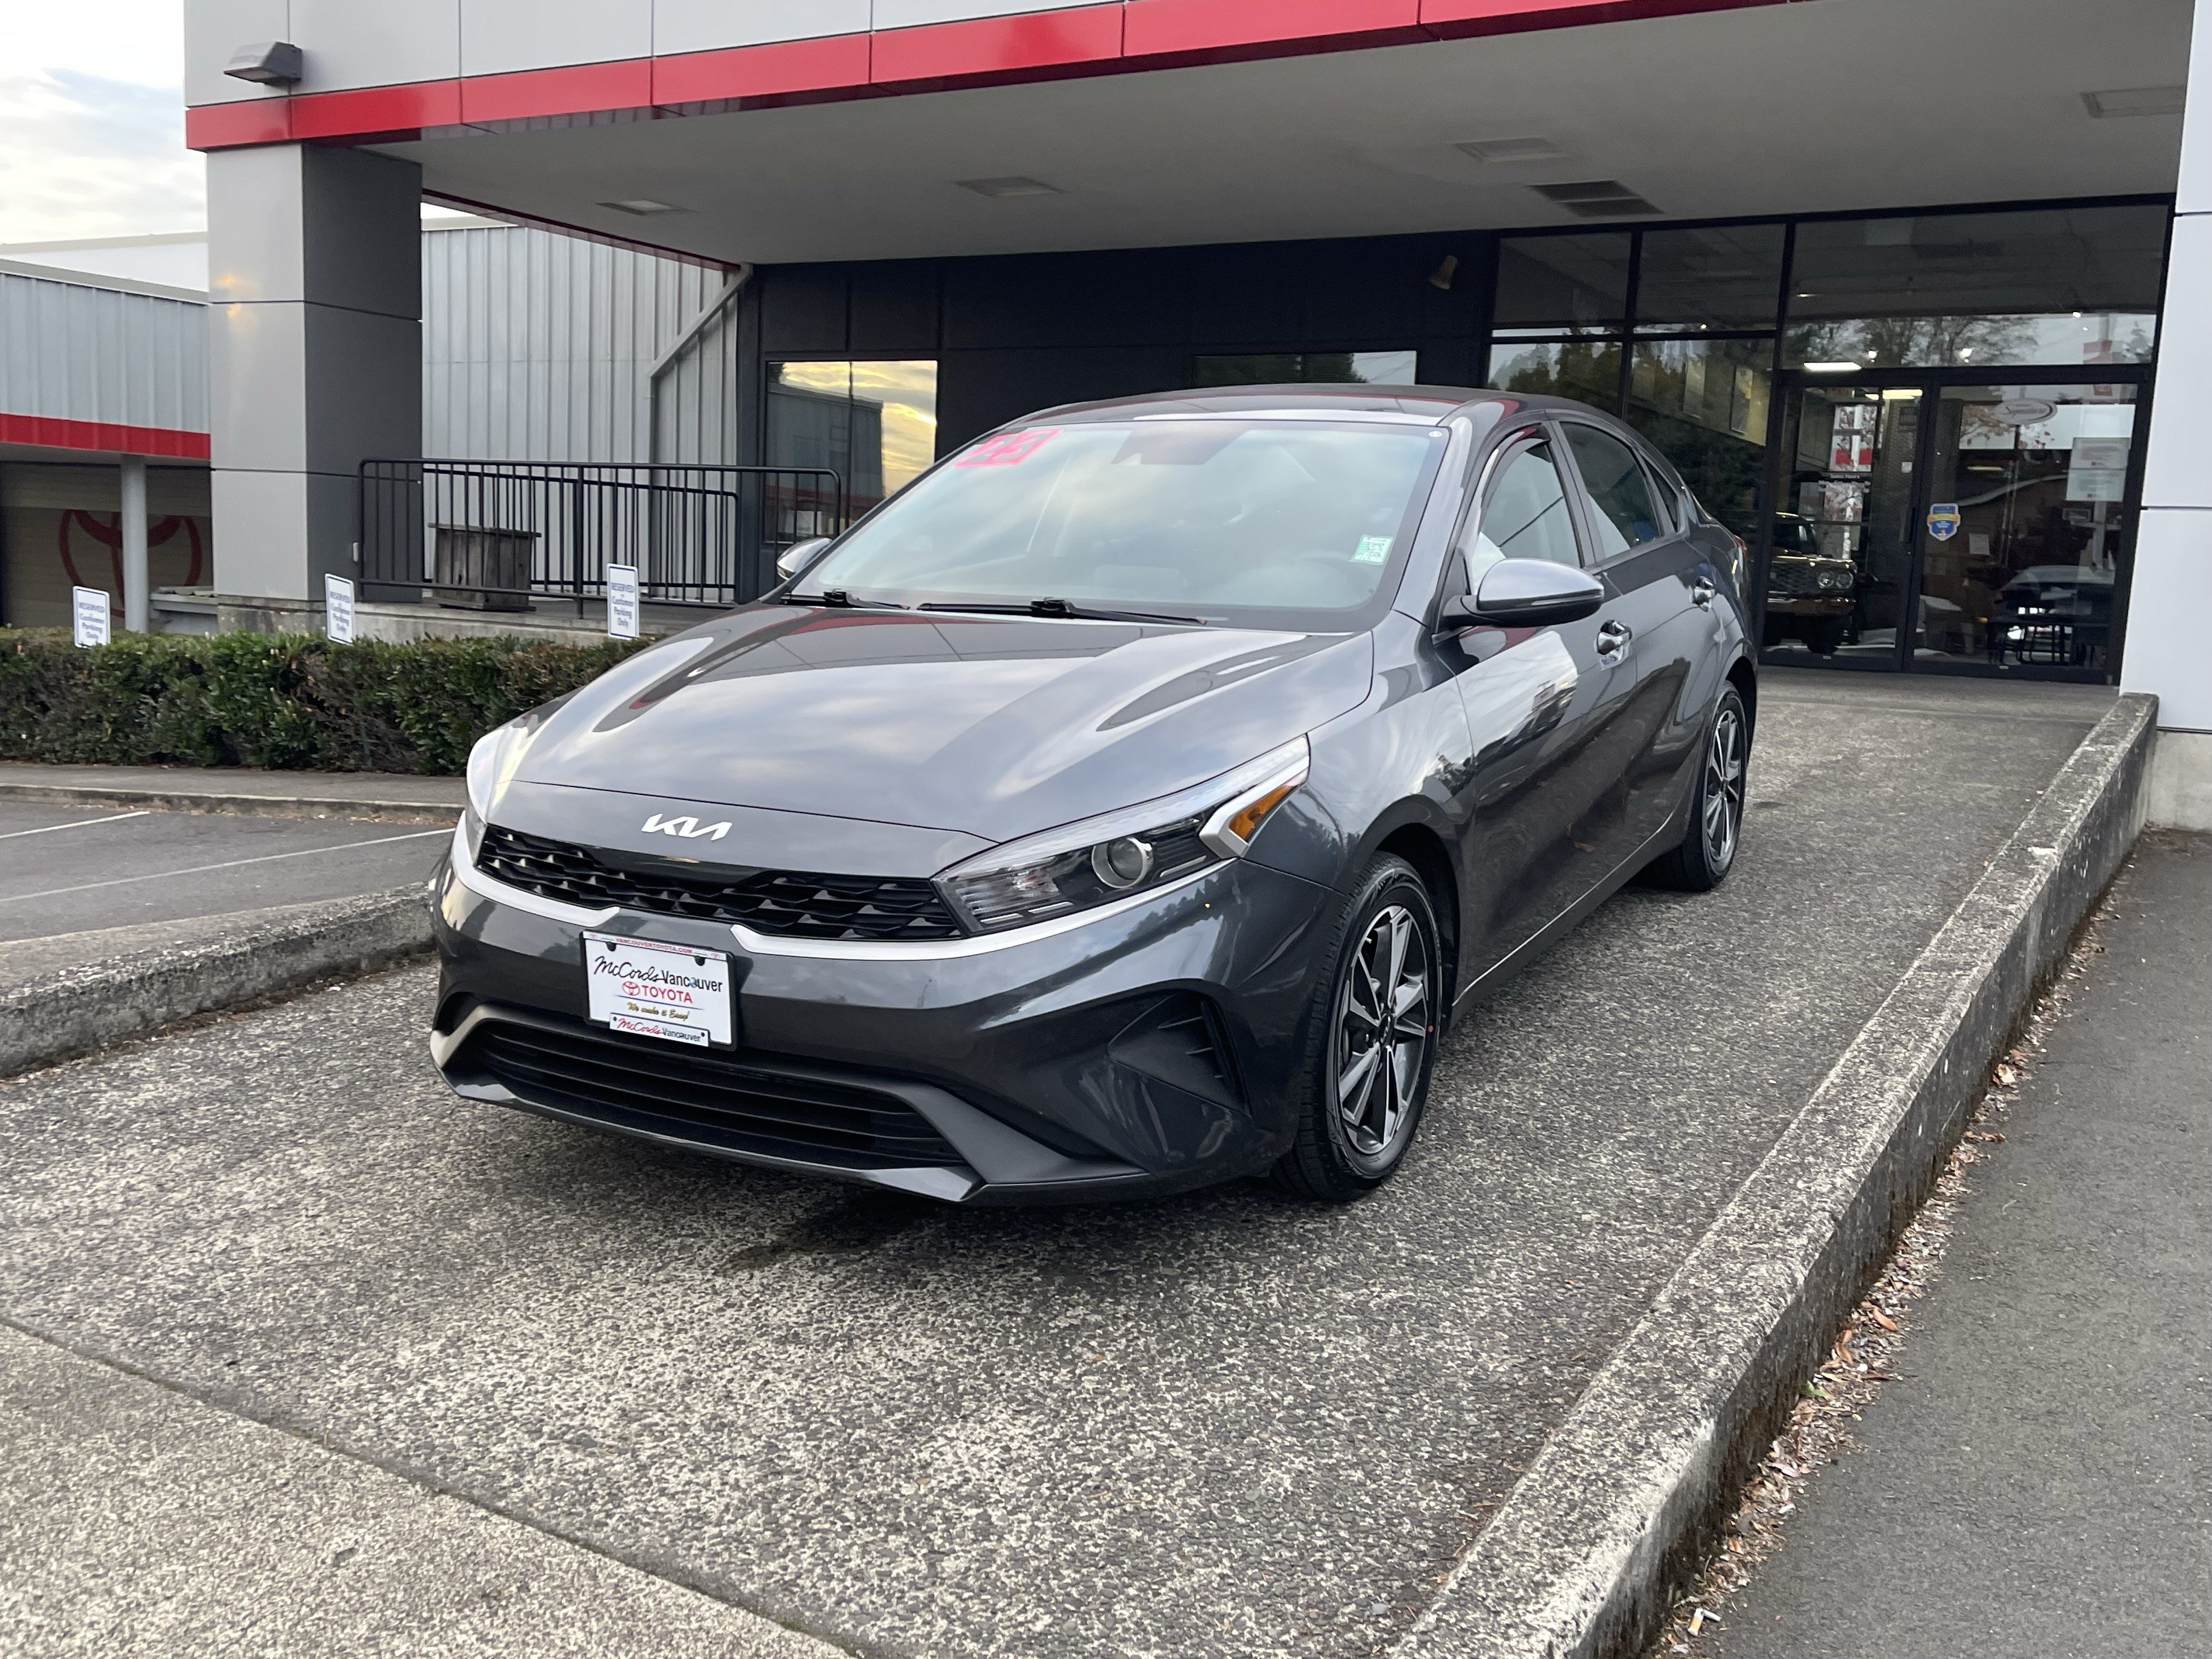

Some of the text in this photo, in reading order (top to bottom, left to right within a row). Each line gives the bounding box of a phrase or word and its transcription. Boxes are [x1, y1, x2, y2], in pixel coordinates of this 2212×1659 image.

[641, 813, 733, 841] KIA
[616, 937, 693, 954] VANCOUVERTOYOTA.COM
[641, 985, 693, 1004] TOYOTA
